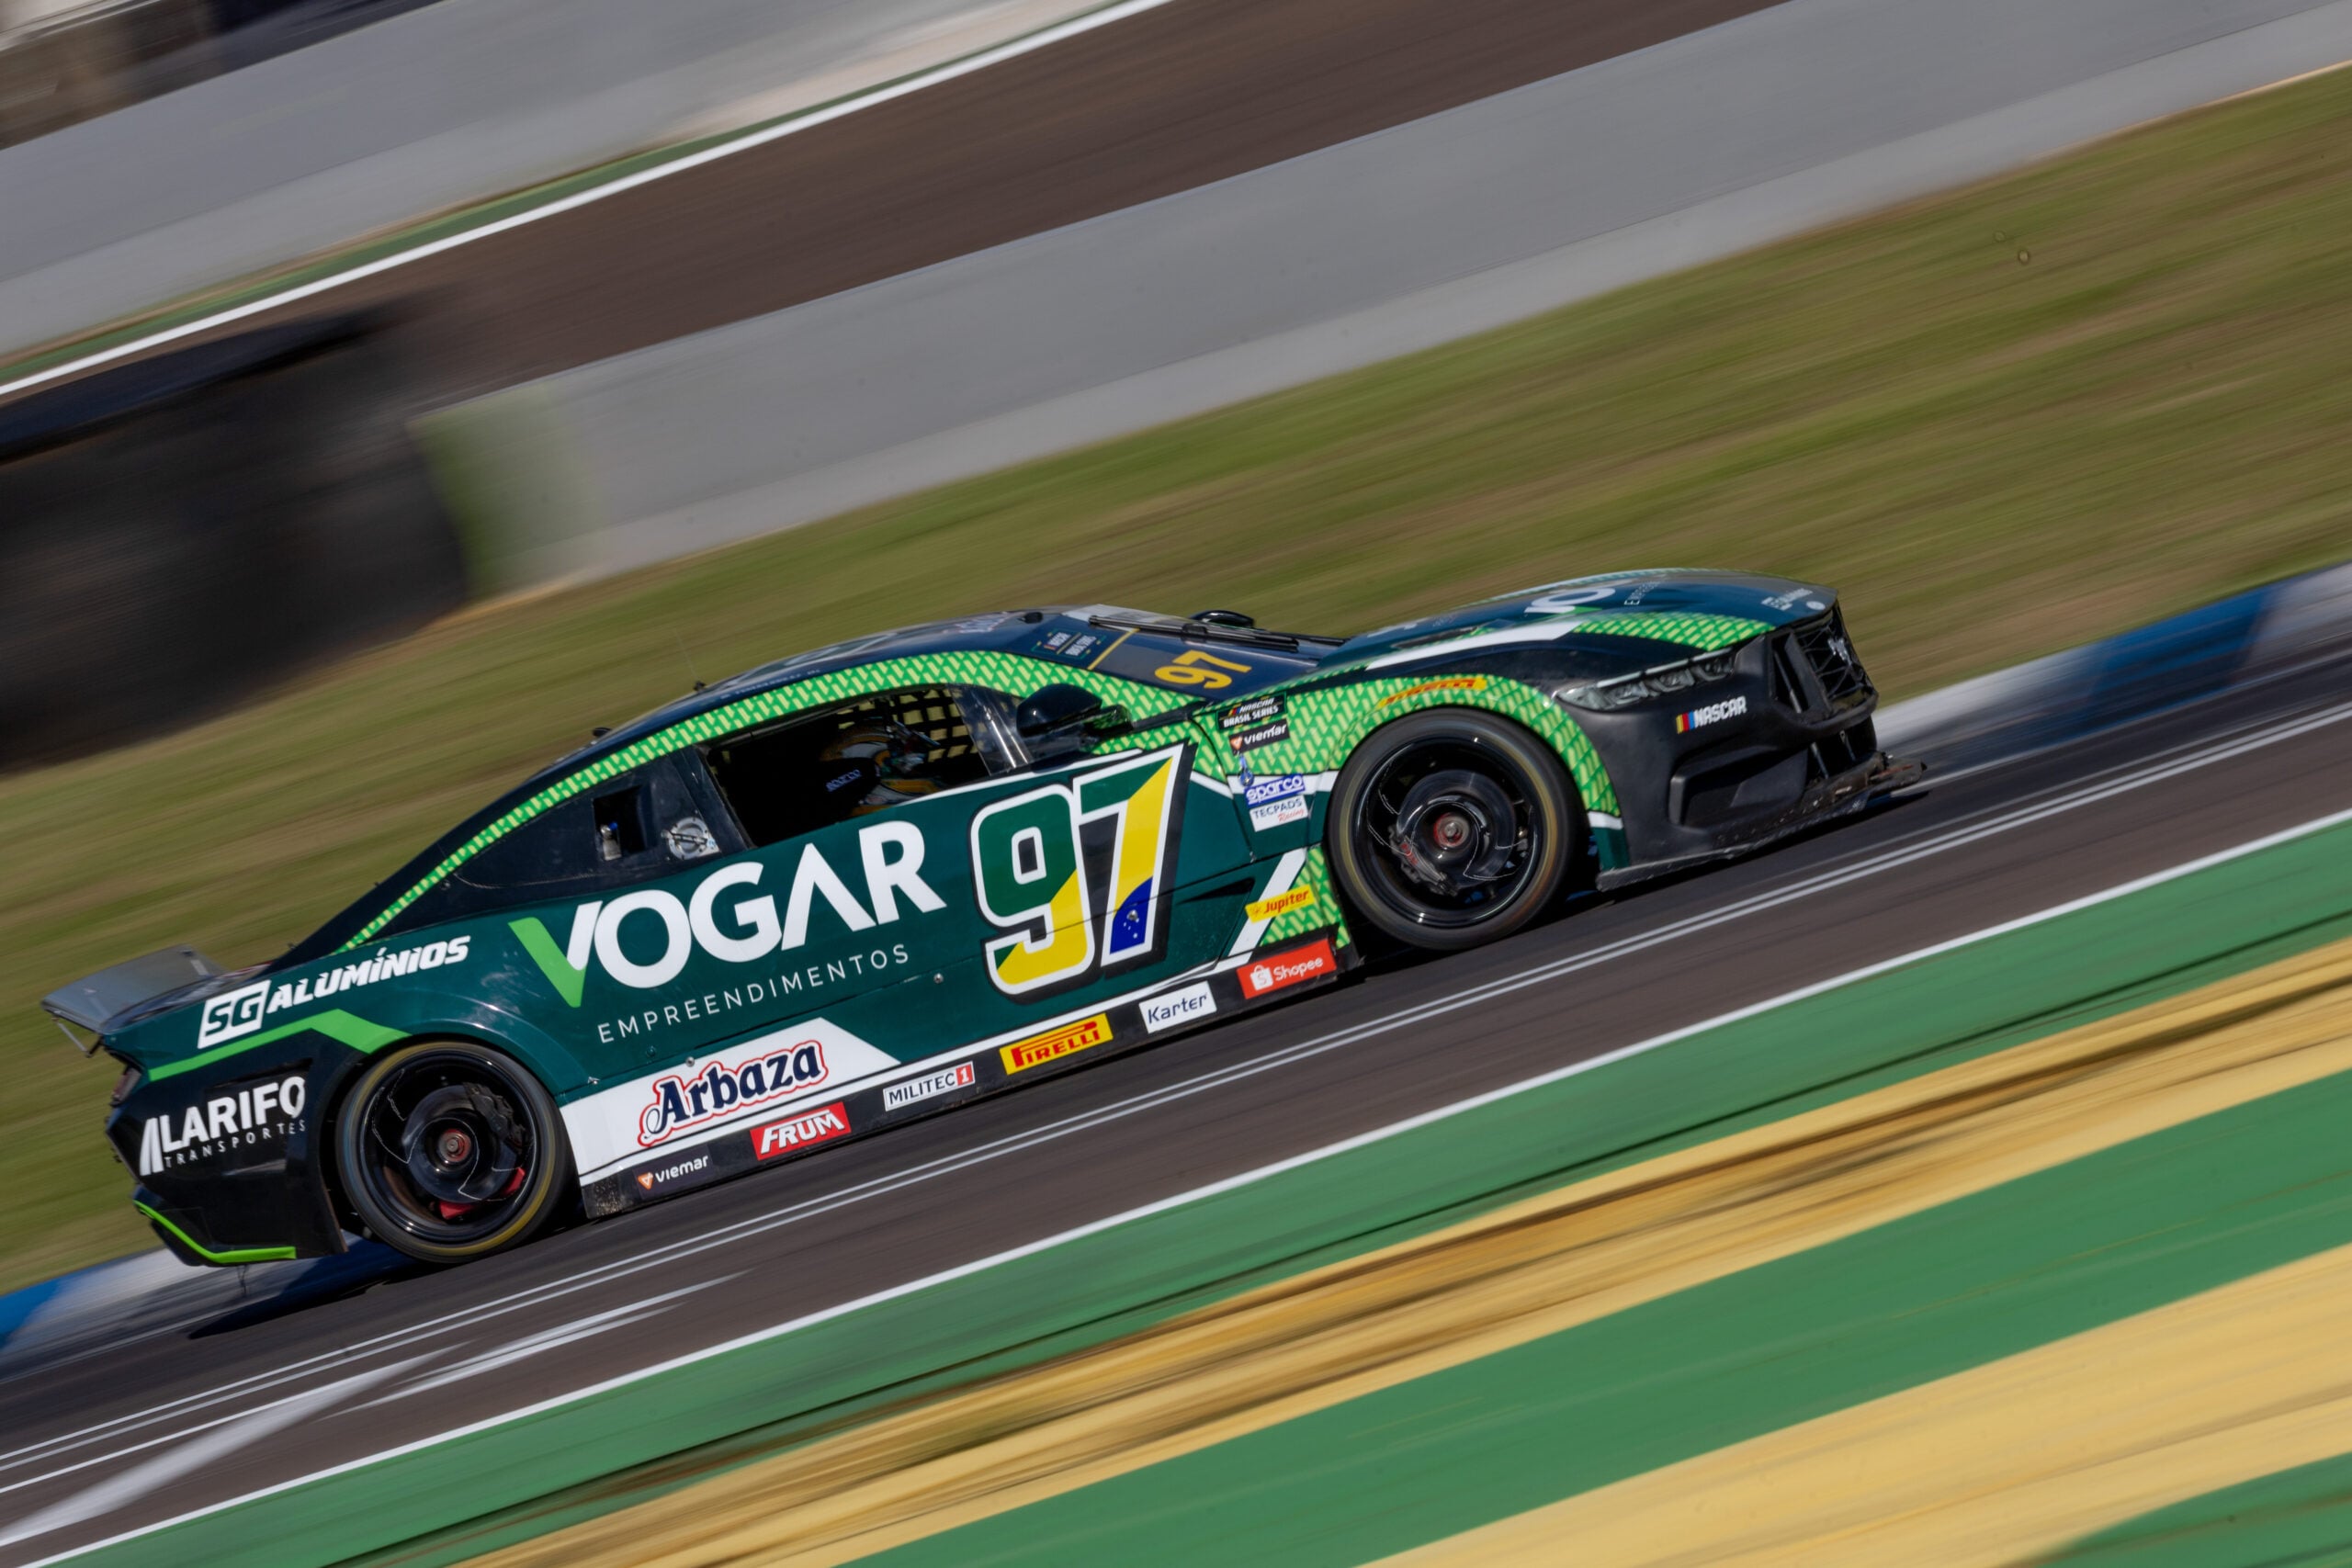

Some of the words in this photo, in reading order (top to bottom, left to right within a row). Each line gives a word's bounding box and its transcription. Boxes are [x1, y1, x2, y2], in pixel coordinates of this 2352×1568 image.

[1154, 649, 1252, 689] 97
[1223, 712, 1251, 728] BRASIL
[1251, 705, 1279, 719] SERIES
[1693, 695, 1747, 728] NASCAR
[1246, 775, 1304, 804] sparco
[1253, 797, 1302, 819] TECPADS
[970, 742, 1185, 995] 97
[508, 820, 948, 1009] VOGAR
[1263, 889, 1309, 914] Jupiter
[202, 987, 266, 1041] SG
[266, 935, 471, 1014] ALUMÍNIOS
[1272, 957, 1324, 982] Shopee
[597, 943, 910, 1044] EMPREENDIMENTOS
[1148, 994, 1208, 1024] Karter
[1011, 1021, 1101, 1068] PIRELLI
[159, 1076, 306, 1154] LARIFO
[643, 1045, 821, 1140] Arbaza
[164, 1120, 306, 1168] TRANSPORTES
[760, 1109, 846, 1155] FRUM
